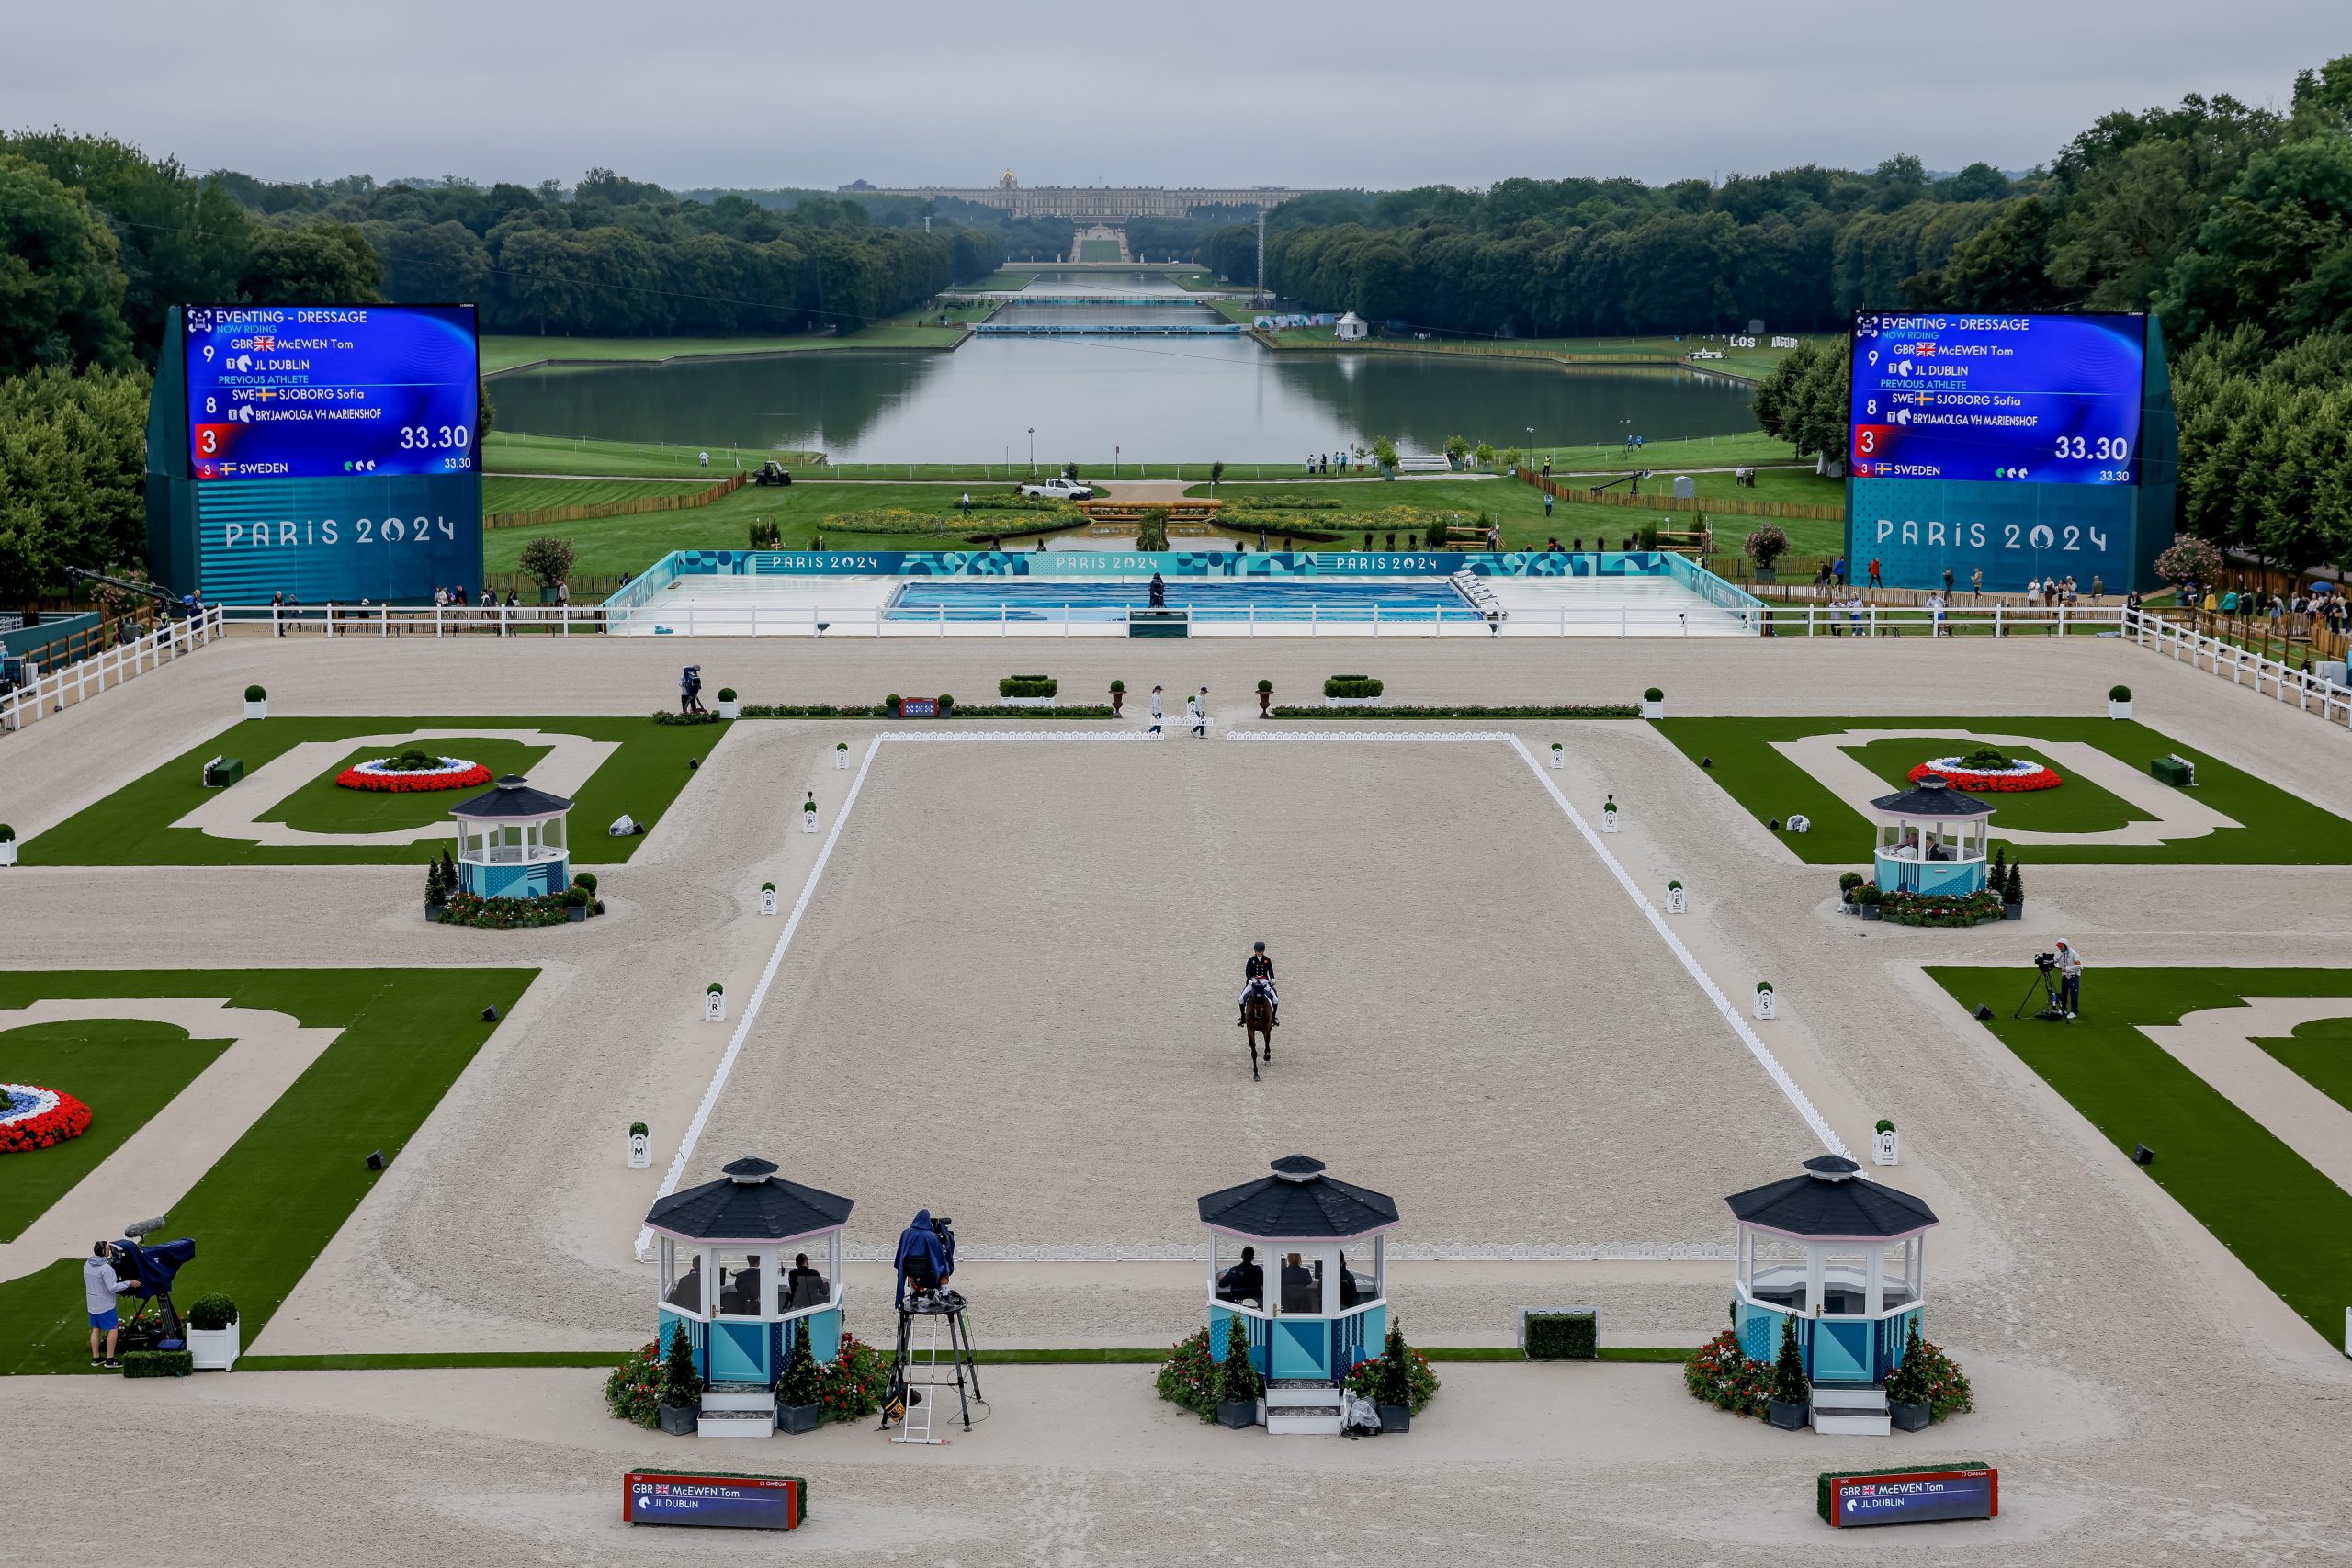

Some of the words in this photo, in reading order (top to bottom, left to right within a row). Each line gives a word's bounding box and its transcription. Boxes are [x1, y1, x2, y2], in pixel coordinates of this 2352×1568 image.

[216, 311, 285, 323] EVENTING
[298, 311, 368, 323] DRESSAGE
[217, 324, 242, 333] NOW
[244, 324, 277, 334] RIDING
[1883, 318, 1947, 331] EVENTING
[1960, 319, 2030, 331] DRESSAGE
[1730, 336, 1756, 348] LOS
[1883, 332, 1905, 340] NOW
[1907, 332, 1939, 341] RIDING
[231, 339, 254, 350] GBR
[277, 339, 328, 350] McEWEN
[331, 339, 354, 349] Tom
[1894, 344, 1916, 355] GBR
[1938, 345, 1988, 356] McEWEN
[1991, 346, 2014, 356] Tom
[203, 345, 215, 362] 9
[1868, 350, 1879, 367] 9
[254, 360, 266, 371] JL
[269, 359, 310, 370] DUBLIN
[1915, 366, 1927, 376] JL
[1928, 366, 1969, 376] DUBLIN
[219, 375, 266, 385] PREVIOUS
[267, 375, 310, 384] ATHLETE
[1881, 379, 1925, 389] PREVIOUS
[1927, 380, 1967, 389] ATHLETE
[232, 389, 255, 400] SWE
[279, 389, 334, 400] SJOBORG
[337, 389, 365, 400] Sofia
[1893, 393, 1914, 404] SWE
[1937, 395, 1991, 406] SJOBORG
[1994, 395, 2021, 406] Sofia
[206, 397, 218, 414] 8
[1867, 400, 1877, 415] 8
[255, 410, 314, 421] BRYJAMOLGA
[314, 409, 327, 420] VH
[329, 408, 382, 420] MARIENSHOF
[1913, 413, 1969, 425] BRYJAMOLGA
[1970, 414, 1982, 425] VH
[1984, 415, 2038, 426] MARIENSHOF
[201, 430, 218, 454] 3
[401, 426, 469, 449] 33.30
[1860, 431, 1874, 453] 3
[2055, 436, 2129, 460] 33.30
[240, 463, 288, 475] SWEDEN
[445, 458, 471, 468] 33.30
[1861, 464, 1868, 474] 3
[204, 465, 211, 475] 3
[1894, 465, 1940, 476] SWEDEN
[2100, 470, 2130, 481] 33.30
[356, 516, 455, 544] 2024
[2004, 524, 2107, 552] 2024
[831, 556, 877, 569] 2024
[1113, 558, 1159, 570] 2024
[1392, 558, 1438, 570] 2024
[633, 1484, 653, 1494] GBR
[673, 1486, 718, 1496] McEWEN
[720, 1488, 740, 1497] Tom
[1840, 1487, 1860, 1497] GBR
[1879, 1483, 1923, 1495] McEWEN
[1925, 1483, 1944, 1492] Tom
[665, 1499, 698, 1508] DUBLIN
[1861, 1500, 1871, 1508] JL
[1872, 1498, 1905, 1508] DUBLIN
